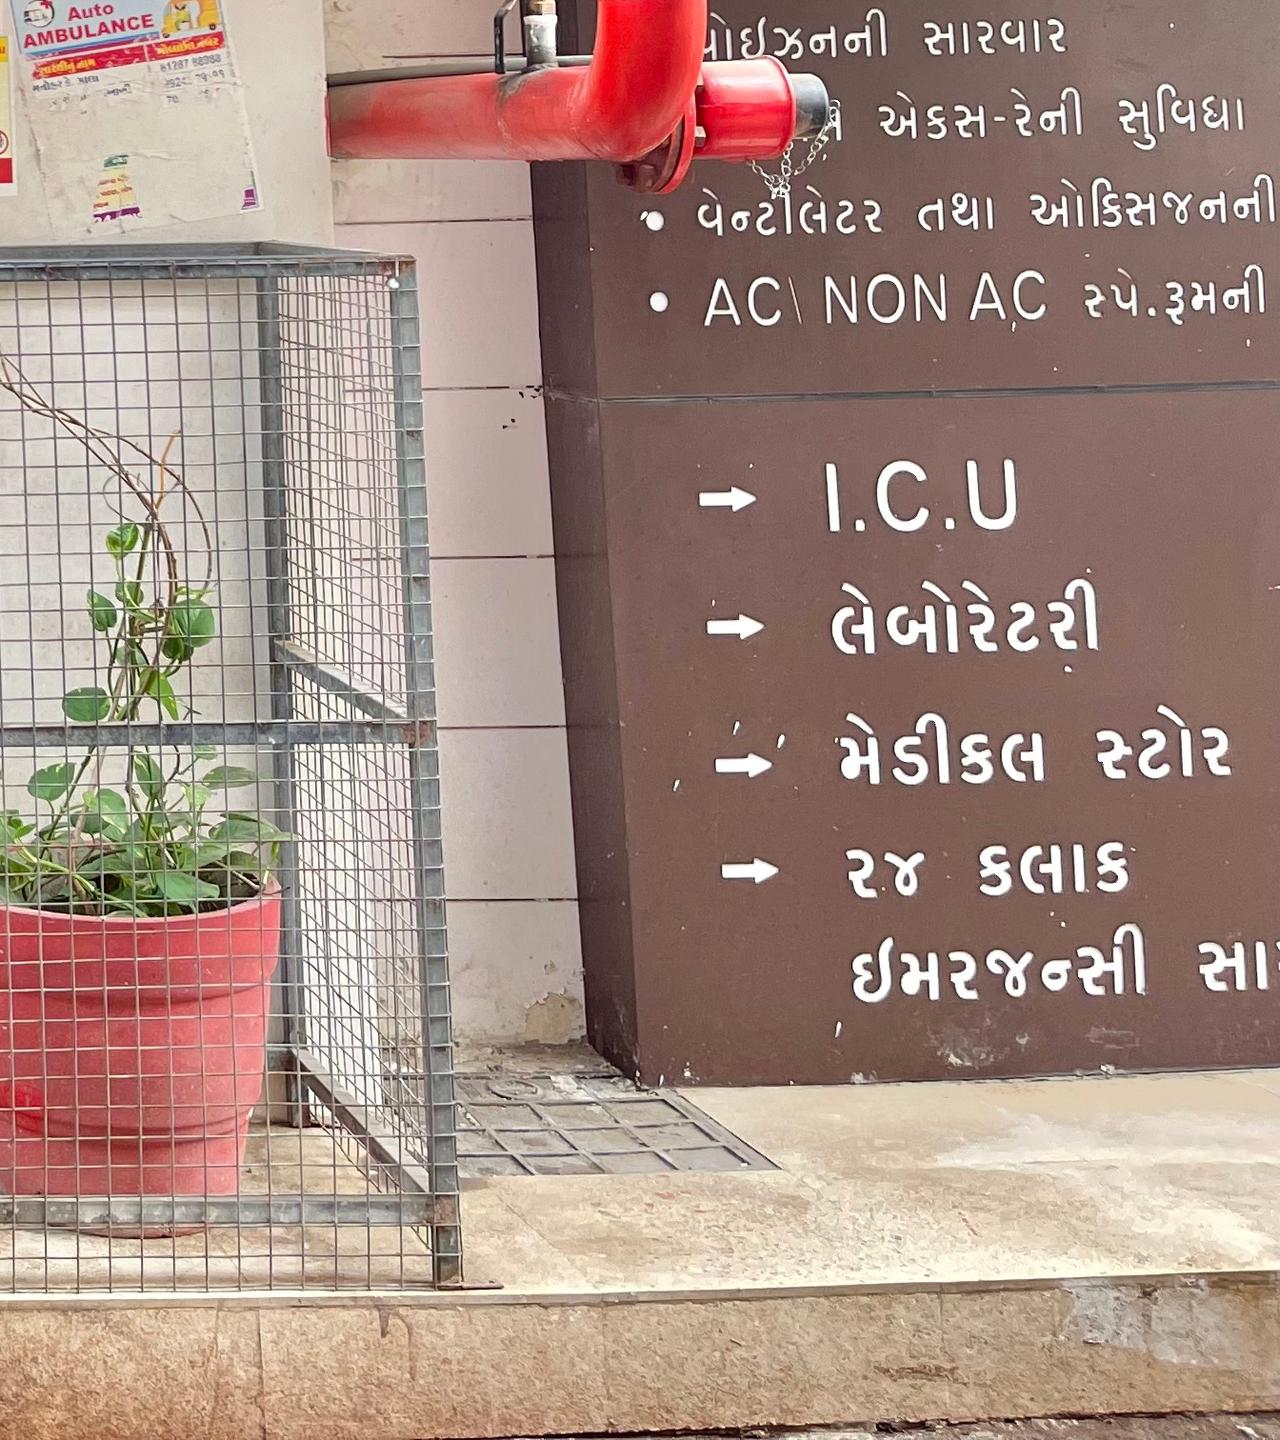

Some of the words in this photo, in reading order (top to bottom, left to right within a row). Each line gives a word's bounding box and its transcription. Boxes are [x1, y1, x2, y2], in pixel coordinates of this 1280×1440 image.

[23, 13, 155, 49] AMBULANCE
[67, 2, 115, 22] Auto
[922, 18, 1068, 57] સારવાર
[1117, 82, 1246, 151] સુવિધા
[697, 185, 884, 237] વેન્ટીલેટર
[916, 190, 996, 233] તથા
[824, 272, 947, 327] NON
[968, 268, 1047, 324] AC
[824, 458, 1018, 532] I.C.U
[830, 576, 1101, 655] લેબોરેટરી
[838, 710, 1046, 786] મેડીકલ
[1095, 704, 1233, 780] સ્ટોર
[977, 840, 1132, 898] કલાક
